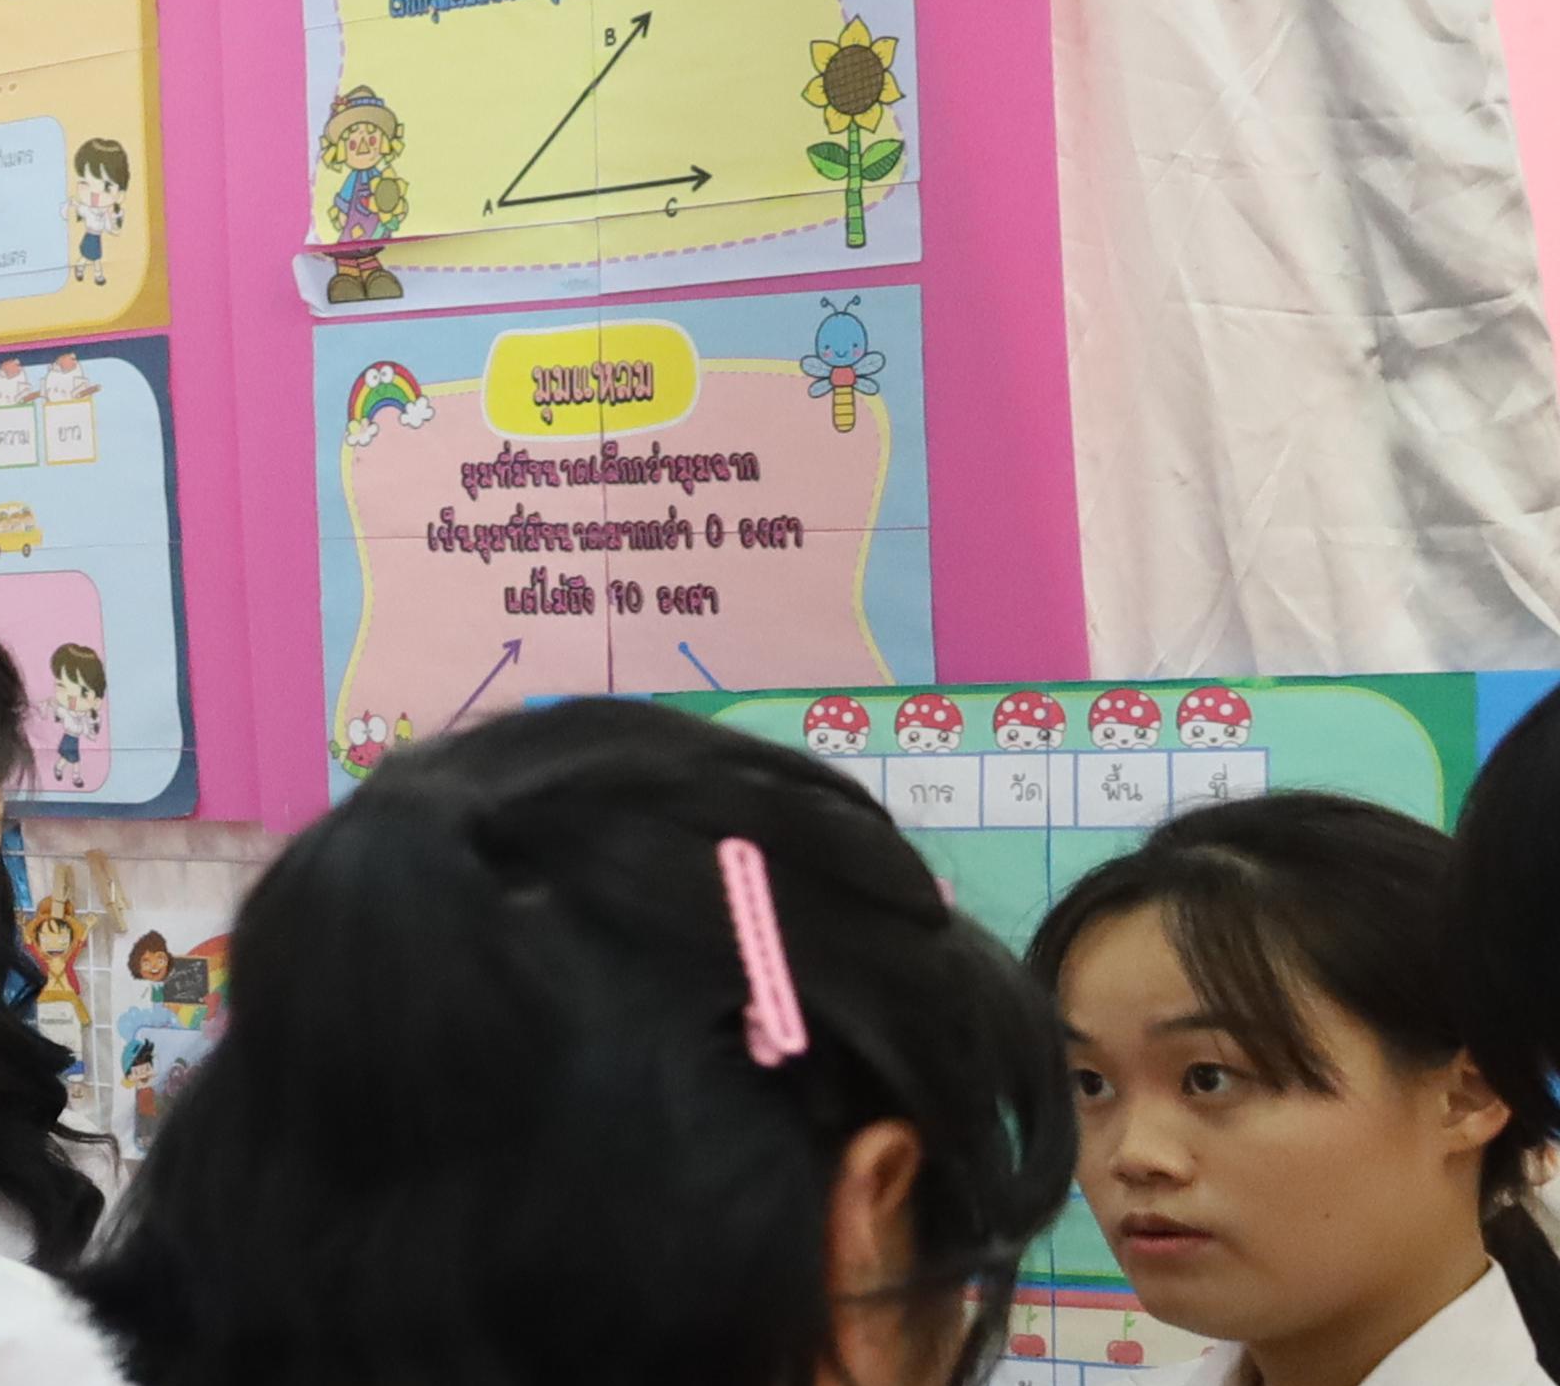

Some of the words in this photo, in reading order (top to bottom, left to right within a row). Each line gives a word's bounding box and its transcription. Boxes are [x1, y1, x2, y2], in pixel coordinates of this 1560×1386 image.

[603, 27, 618, 47] B
[482, 201, 496, 218] A
[663, 197, 679, 219] C
[532, 359, 655, 426] มุมแหลม
[56, 423, 83, 443] ยาว
[909, 779, 956, 806] การ
[1010, 767, 1044, 804] วัด
[1100, 761, 1144, 805] พื้น
